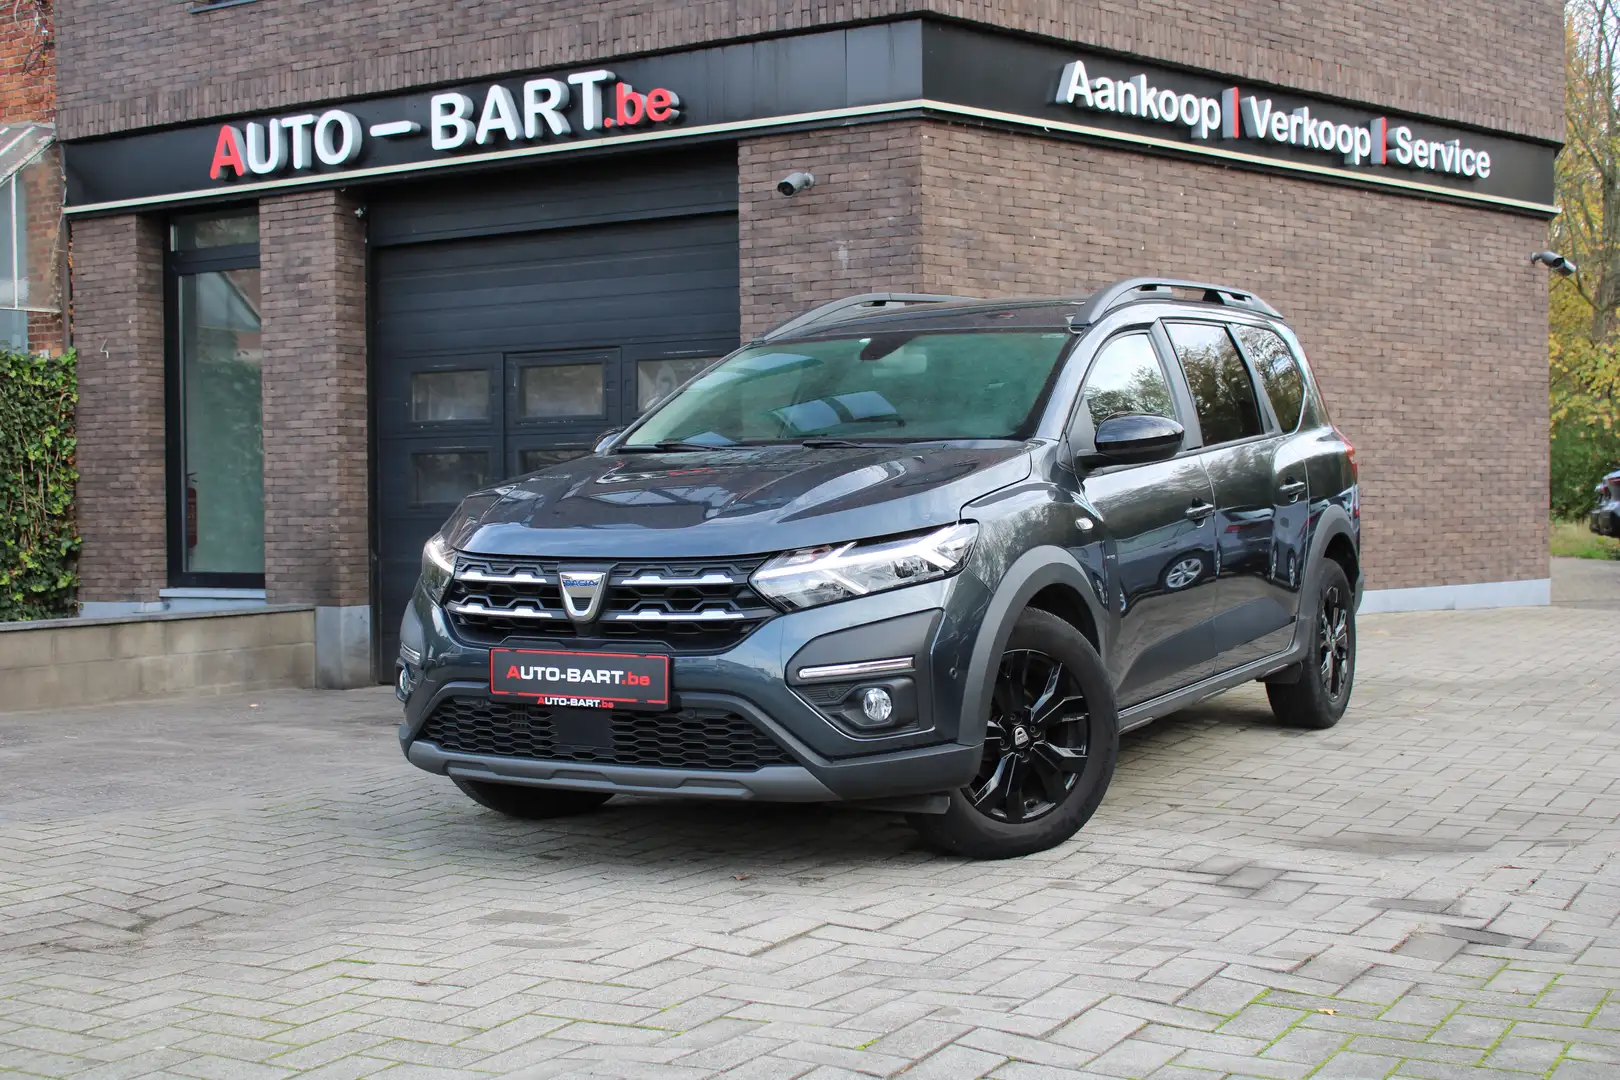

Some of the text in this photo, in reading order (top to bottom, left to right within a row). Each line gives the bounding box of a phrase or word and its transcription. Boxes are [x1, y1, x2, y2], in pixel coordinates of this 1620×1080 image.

[1057, 60, 1492, 179] Aankoop Verkoop Service
[564, 579, 598, 587] DACIA
[506, 665, 650, 685] AUTO-BART.be
[537, 697, 614, 708] AUTO-BART.be
